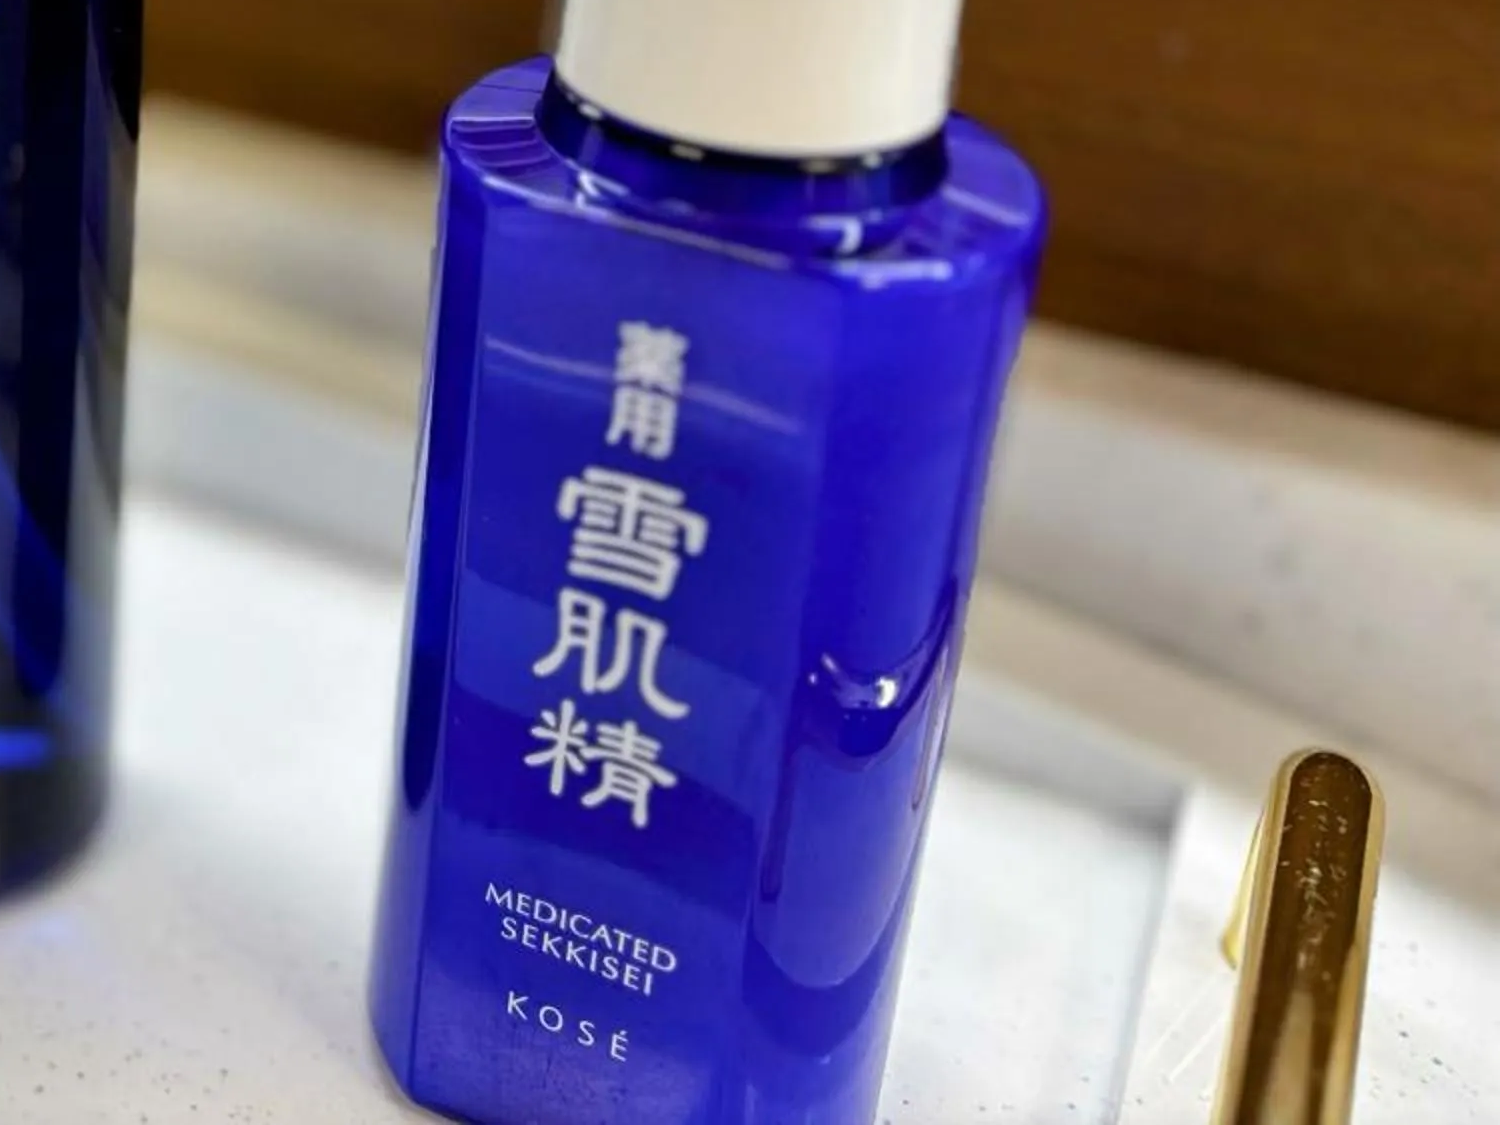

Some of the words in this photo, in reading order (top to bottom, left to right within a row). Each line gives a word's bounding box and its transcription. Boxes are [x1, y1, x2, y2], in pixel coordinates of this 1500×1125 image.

[524, 466, 709, 829] 雪肌精
[485, 881, 678, 972] MEDICATED
[501, 916, 653, 997] SEKKISEI
[507, 990, 629, 1062] KOSÉ
